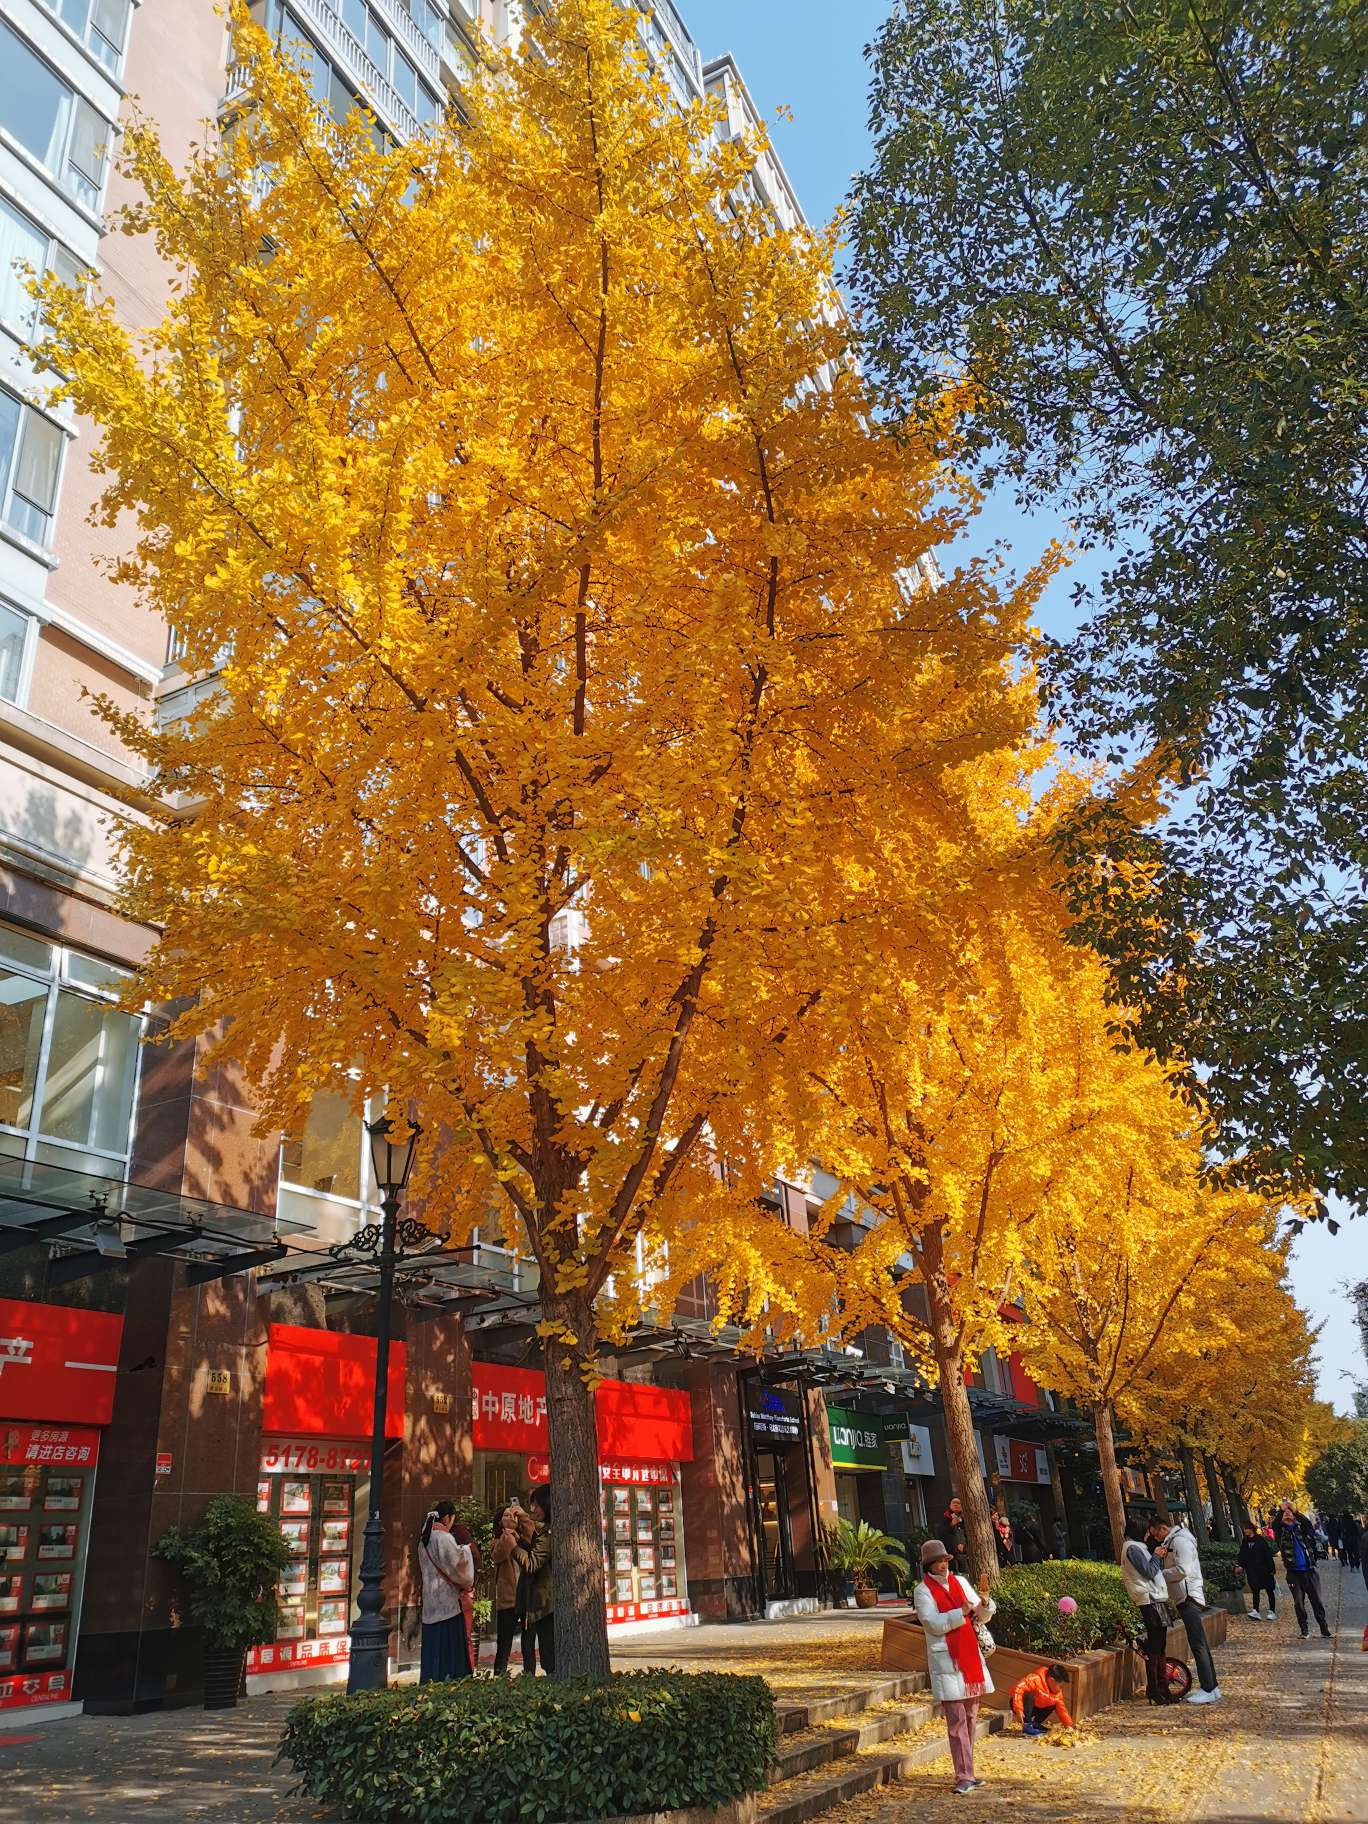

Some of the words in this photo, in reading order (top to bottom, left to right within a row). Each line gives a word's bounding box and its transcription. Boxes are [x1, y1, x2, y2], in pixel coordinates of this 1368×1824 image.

[481, 1389, 548, 1427] 中原地产
[25, 1444, 91, 1461] 请进店咨询
